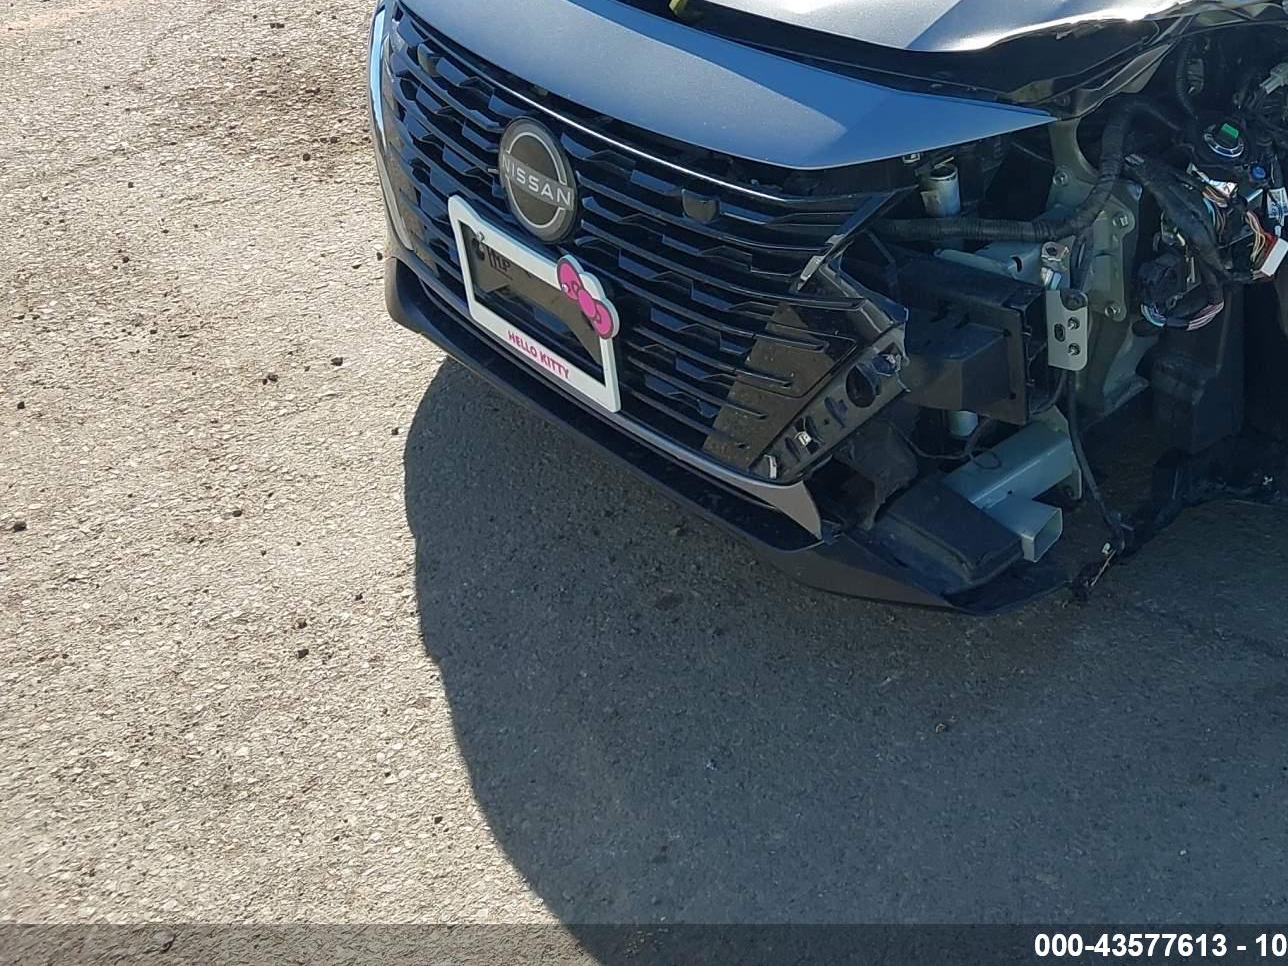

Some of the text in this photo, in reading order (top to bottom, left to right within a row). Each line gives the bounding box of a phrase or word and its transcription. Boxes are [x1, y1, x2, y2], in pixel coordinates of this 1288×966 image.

[502, 154, 571, 206] NISSAN
[507, 330, 569, 379] HELLO KITTY
